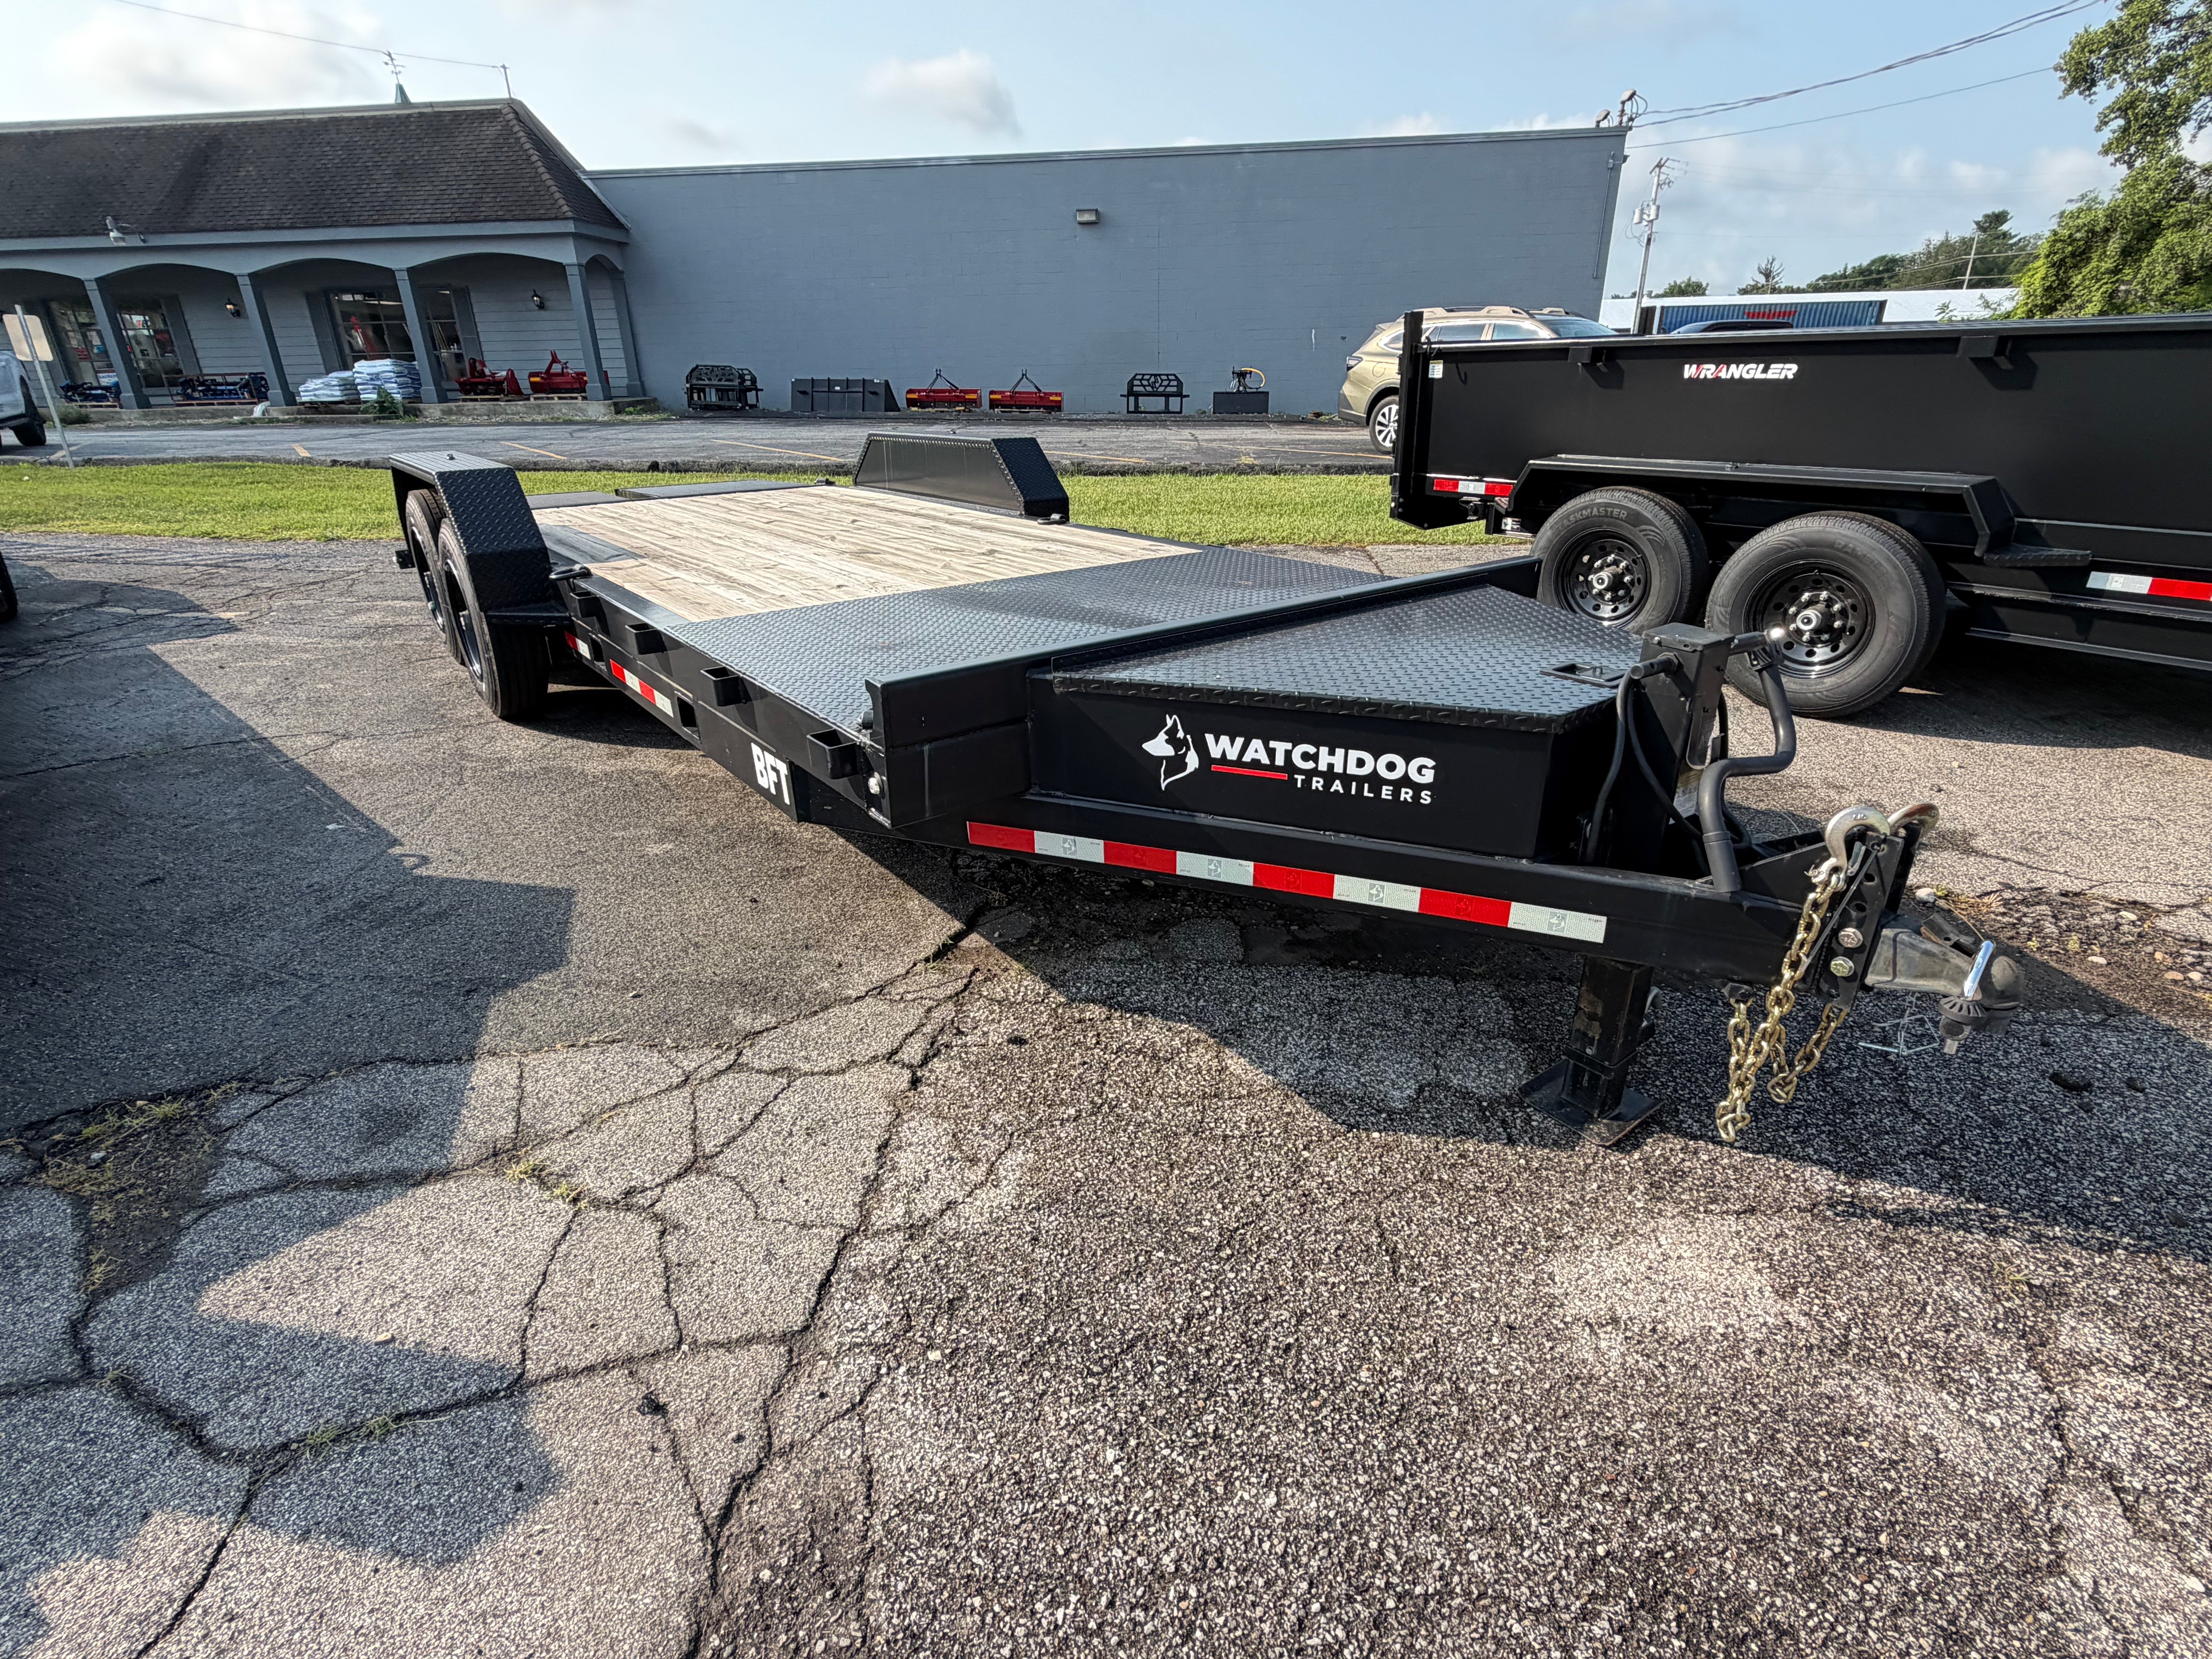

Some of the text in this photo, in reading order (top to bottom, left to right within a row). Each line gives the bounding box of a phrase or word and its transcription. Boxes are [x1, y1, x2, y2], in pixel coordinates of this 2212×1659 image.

[1684, 363, 1798, 378] WRANGLER
[751, 742, 790, 805] BFT
[1204, 733, 1436, 784] WATCHDOG
[1294, 774, 1432, 804] TRAILERS
